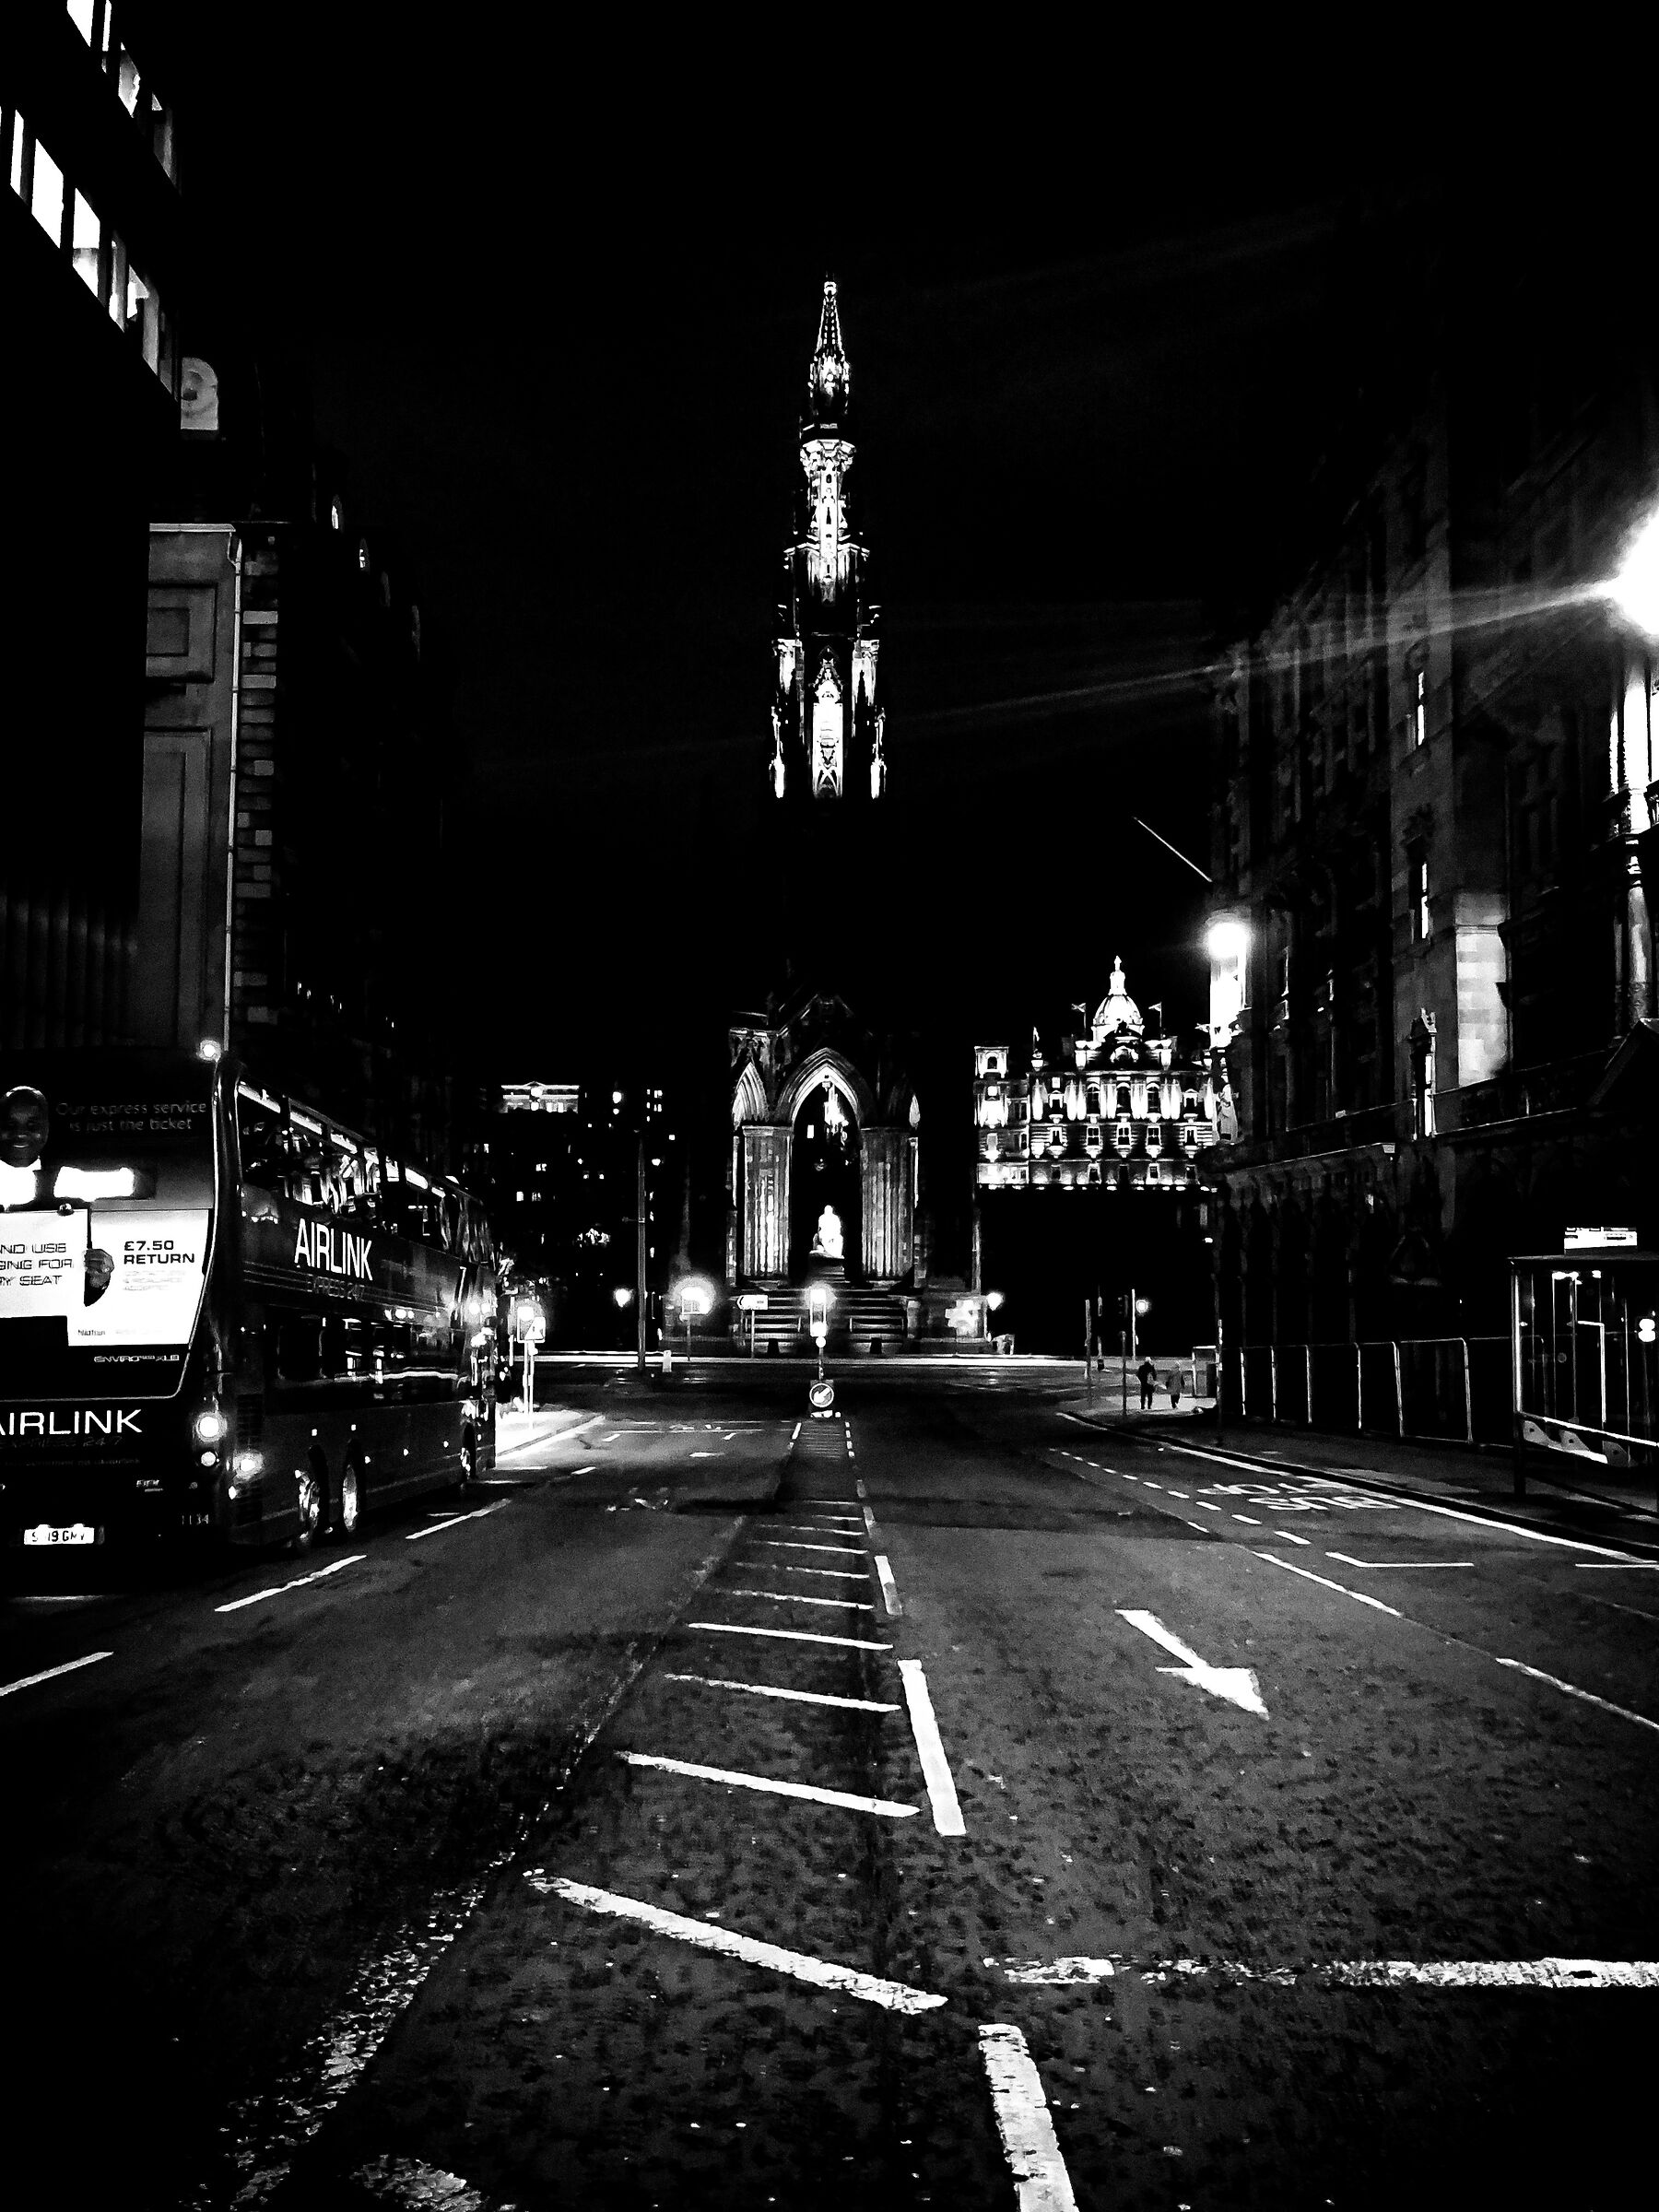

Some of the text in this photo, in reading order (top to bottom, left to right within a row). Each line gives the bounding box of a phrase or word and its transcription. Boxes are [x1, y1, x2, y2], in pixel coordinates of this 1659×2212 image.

[90, 1103, 147, 1116] express
[153, 1100, 206, 1113] service
[86, 1120, 114, 1133] just
[119, 1118, 144, 1131] the
[149, 1116, 192, 1130] ticket
[32, 1242, 67, 1253] USE
[124, 1240, 174, 1252] £7.50
[294, 1218, 373, 1281] AIRLINK
[38, 1259, 74, 1269] FOR
[124, 1253, 195, 1265] RETURN
[19, 1275, 63, 1287] SEAT
[0, 1408, 143, 1436] IRLINK
[1249, 1496, 1401, 1511] BUS
